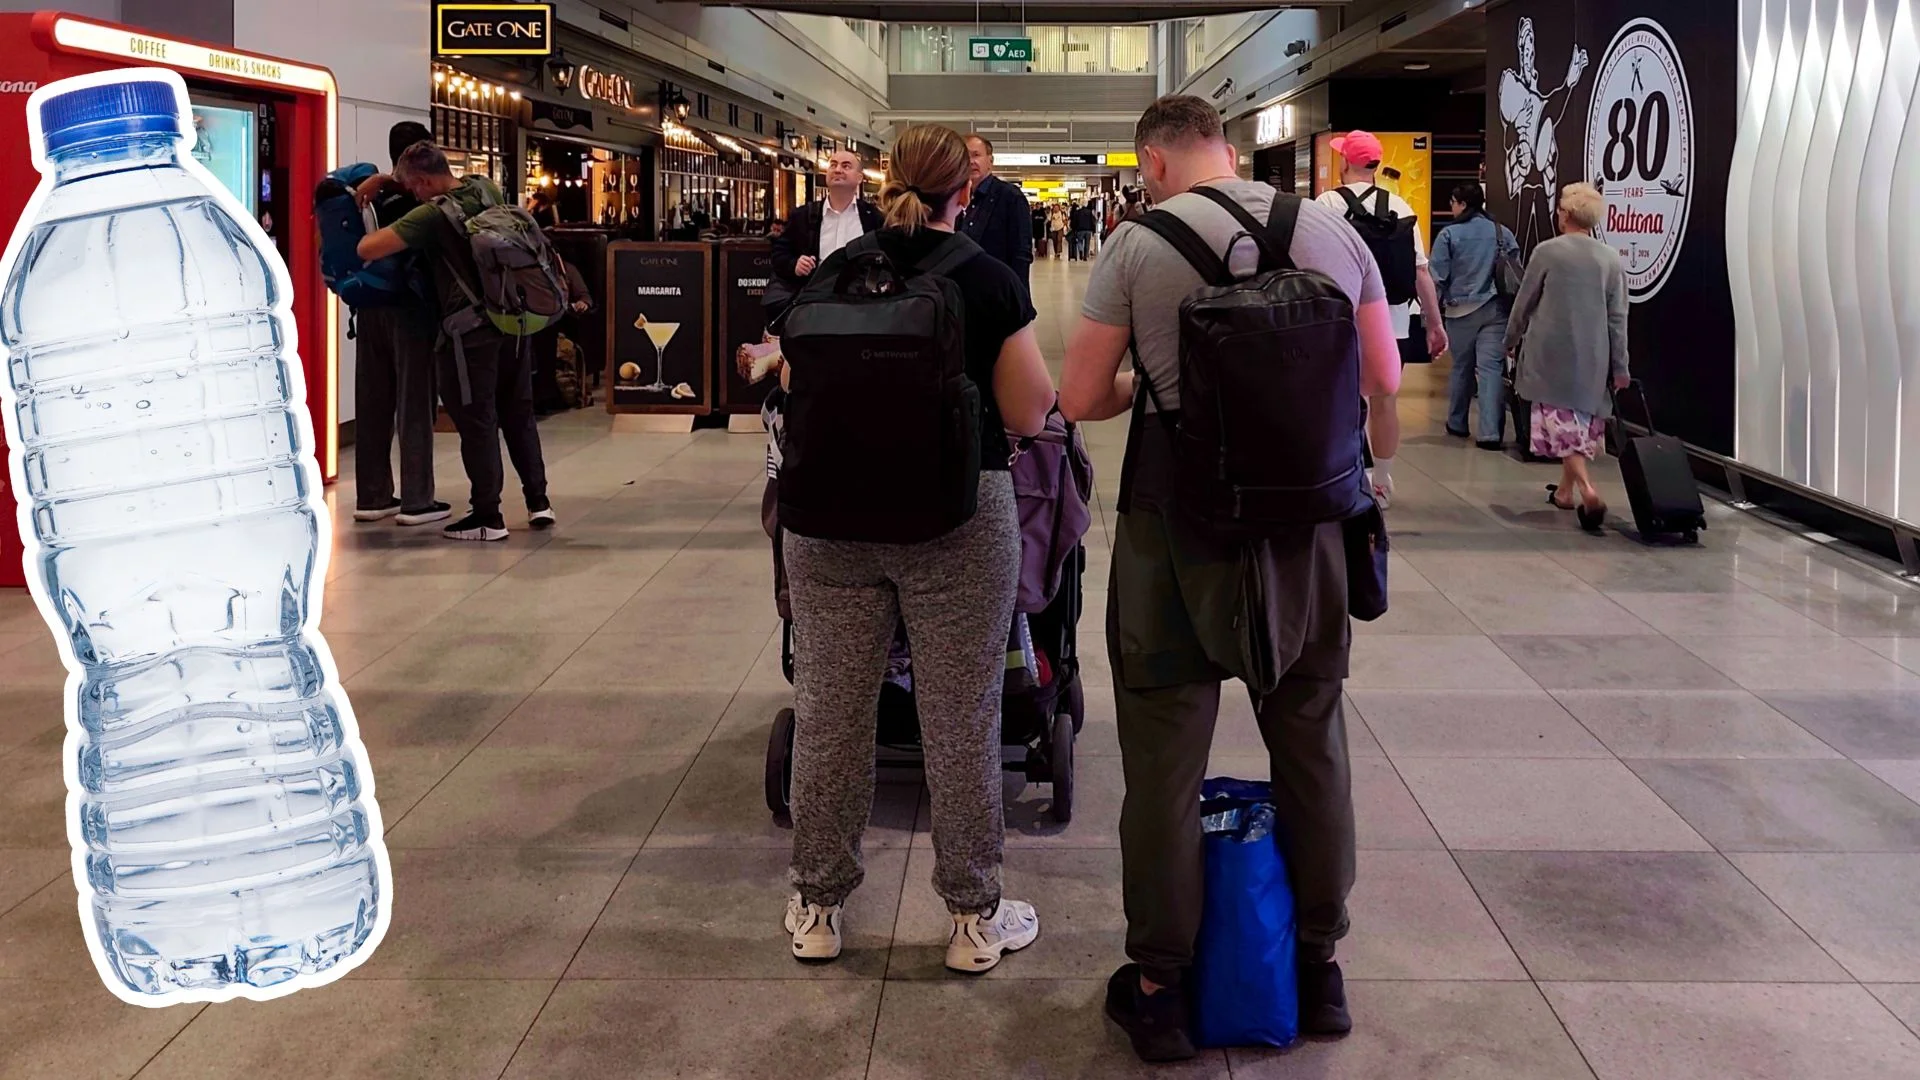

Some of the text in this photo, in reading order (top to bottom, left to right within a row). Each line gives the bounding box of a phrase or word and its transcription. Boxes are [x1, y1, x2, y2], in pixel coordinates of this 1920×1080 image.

[447, 20, 542, 38] GATE ONE
[1636, 34, 1657, 48] RETAIL
[130, 36, 282, 80] COFFEE DRINKS & SNACKS
[1007, 49, 1026, 58] AED
[1602, 90, 1670, 182] 80
[1623, 187, 1644, 198] YEARS
[1606, 203, 1664, 234] Baltona
[638, 286, 682, 297] MARGARITA
